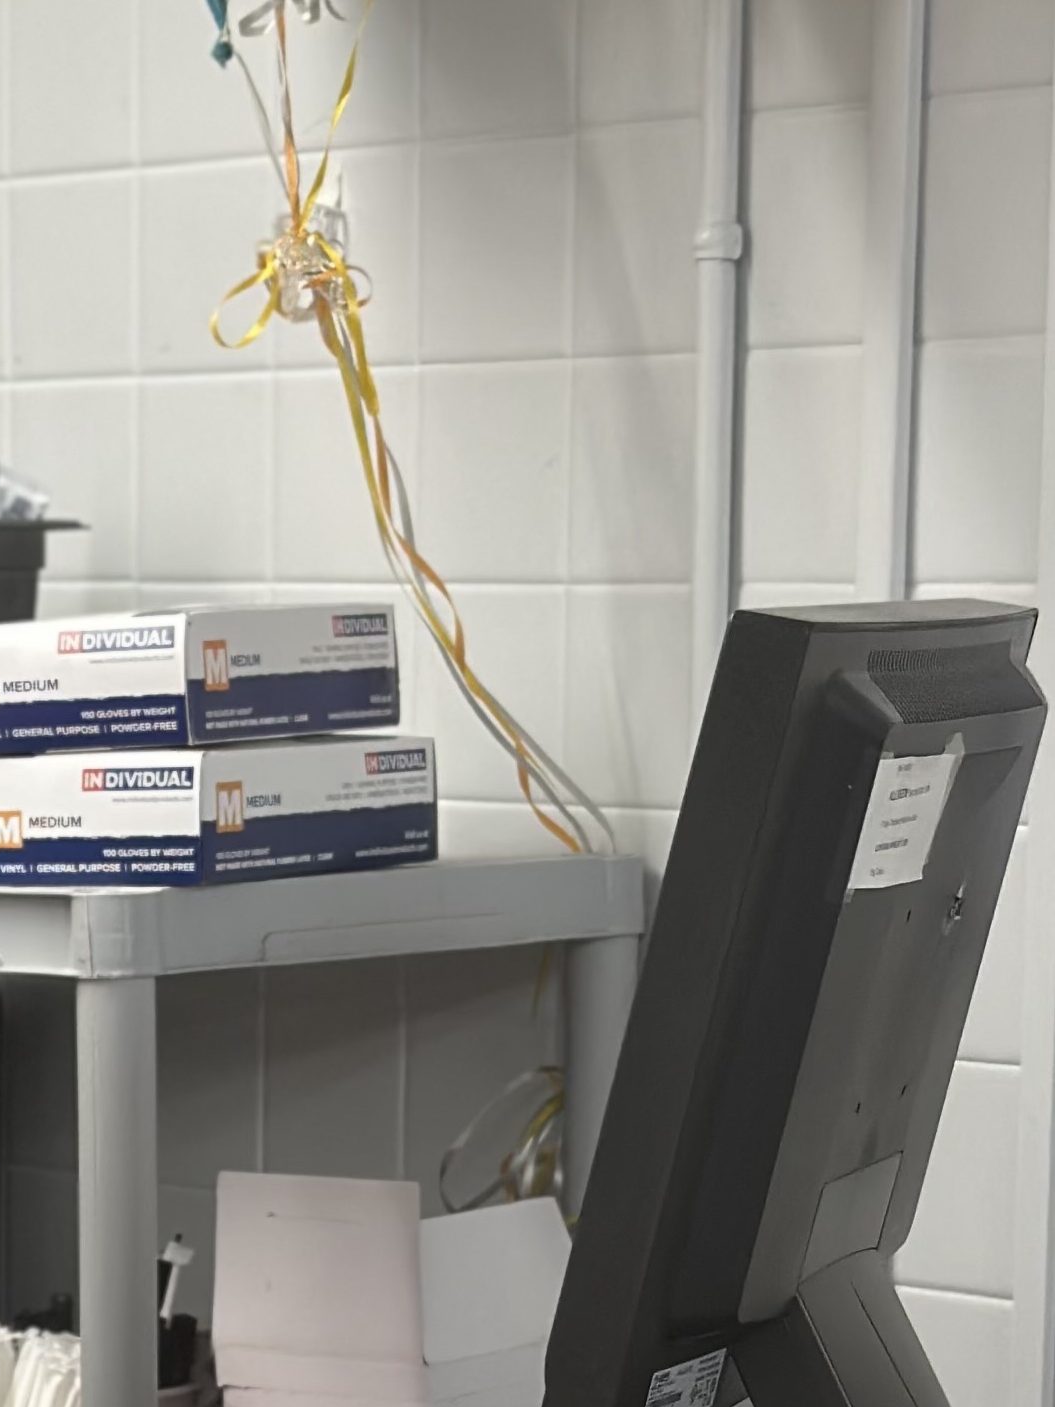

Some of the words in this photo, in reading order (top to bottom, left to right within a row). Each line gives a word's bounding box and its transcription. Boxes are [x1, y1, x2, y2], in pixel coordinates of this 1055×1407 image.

[333, 617, 387, 637] INDIVIDUAL
[60, 629, 174, 651] INDIVIDUAL
[204, 648, 228, 685] M
[230, 654, 261, 667] MEDIUM
[2, 678, 59, 693] MEDIUM
[96, 710, 129, 719] GLOVES
[130, 709, 142, 718] BY
[142, 706, 176, 717] WEIGHT
[12, 727, 55, 738] GENERAL
[56, 725, 100, 736] PURPOSE
[110, 721, 178, 734] POWDER-FREE
[366, 753, 427, 774] INDIVIDUAL
[84, 770, 193, 789] INDIVIDUAL
[218, 790, 241, 827] M
[246, 794, 282, 808] MEDIUM
[28, 815, 82, 829] MEDIUM
[117, 849, 149, 857] GLOVES
[150, 849, 161, 857] BY
[161, 848, 195, 857] WEIGHT
[0, 864, 27, 874] VINYL
[36, 864, 77, 873] GENERAL
[78, 863, 121, 873] PURPOSE
[131, 862, 196, 873] POWDER-FREE
